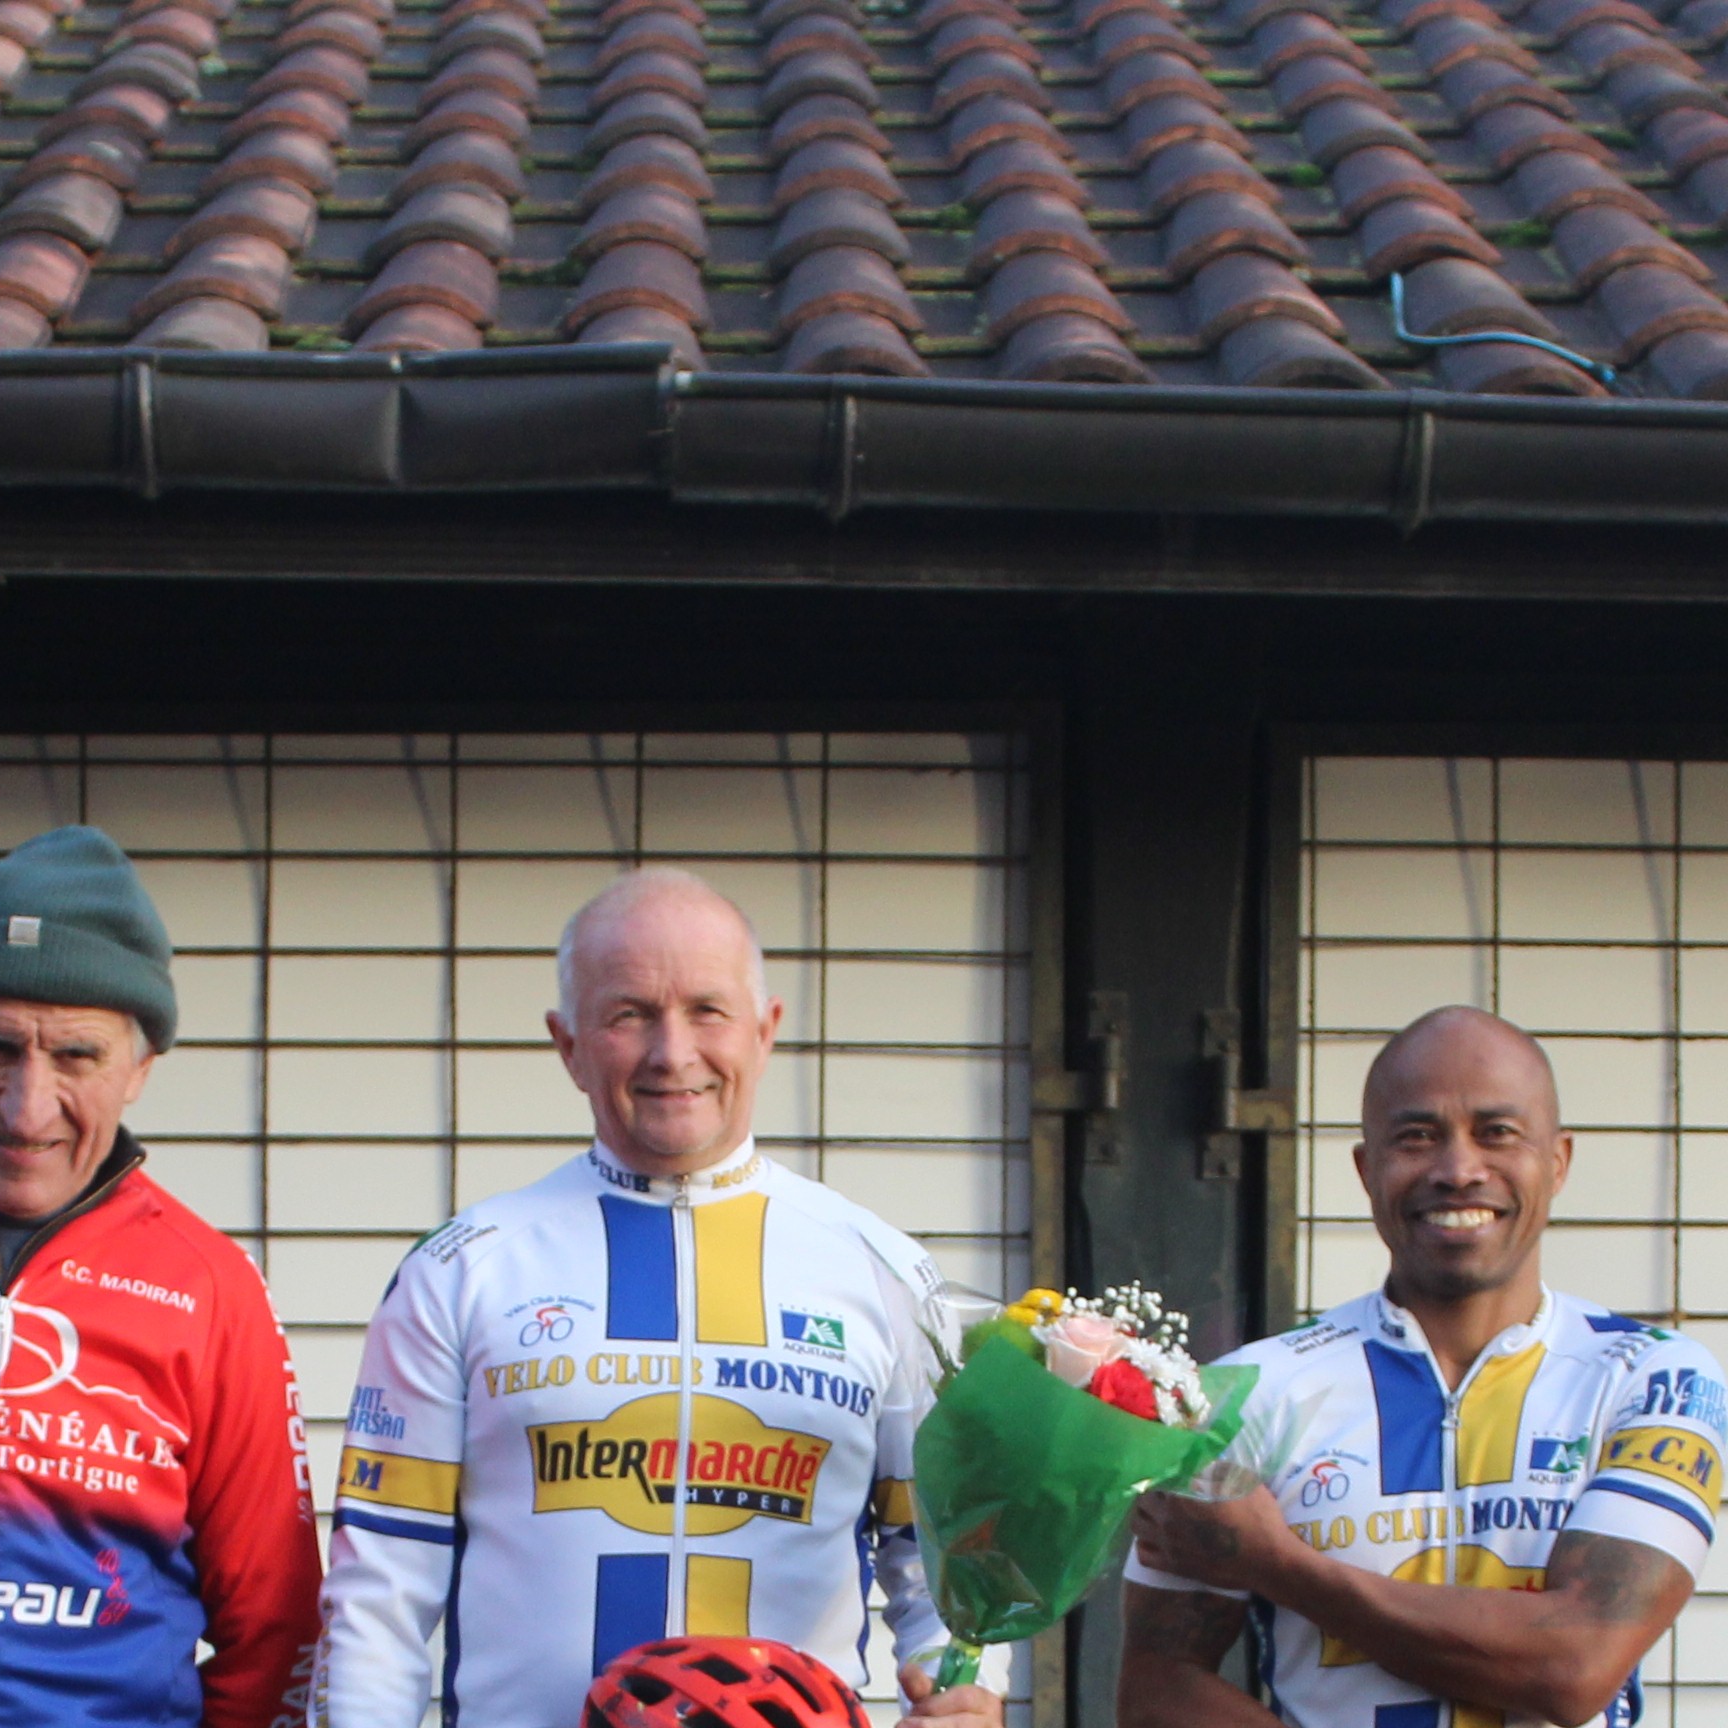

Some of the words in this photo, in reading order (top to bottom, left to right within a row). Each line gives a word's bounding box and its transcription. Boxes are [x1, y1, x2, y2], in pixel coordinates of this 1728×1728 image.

[98, 1274, 196, 1315] MADIRAN
[783, 1340, 847, 1363] AQUITAINE
[483, 1354, 576, 1399] VELO
[586, 1352, 705, 1387] CLUB
[715, 1357, 876, 1418] MONTOIS
[535, 1426, 823, 1504] Intermarché
[684, 1487, 793, 1515] HYPER
[1365, 1505, 1466, 1545] CLUB
[1471, 1495, 1577, 1535] MONT
